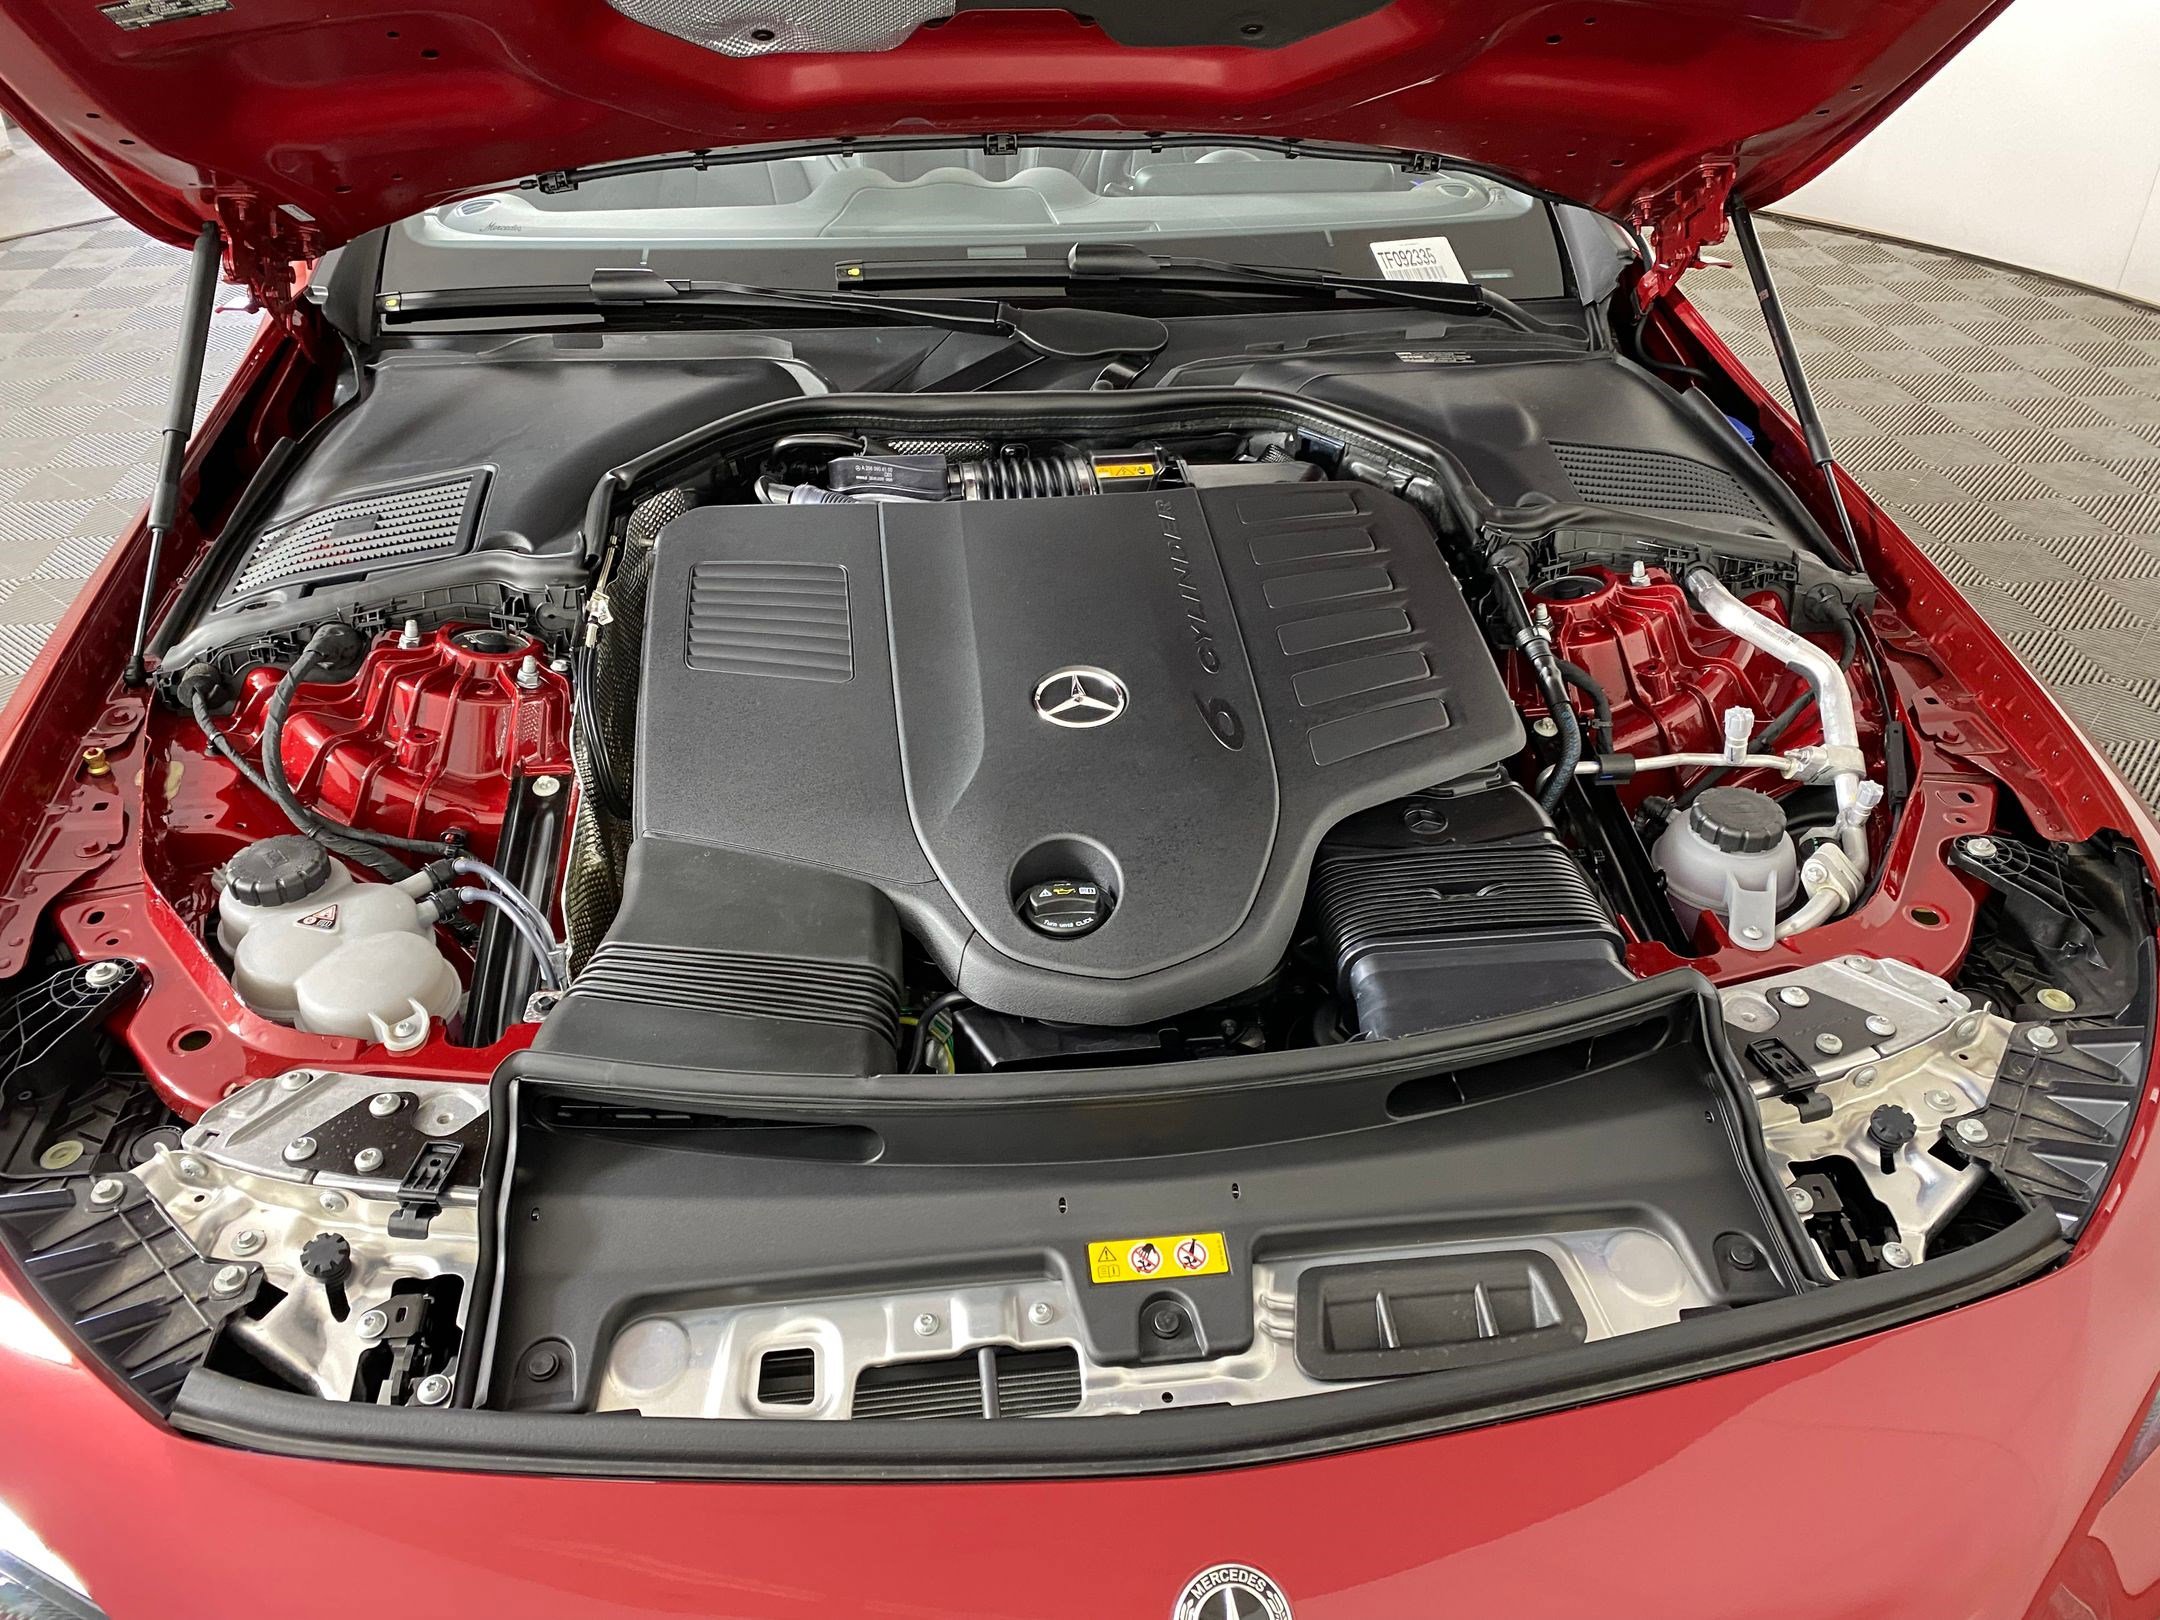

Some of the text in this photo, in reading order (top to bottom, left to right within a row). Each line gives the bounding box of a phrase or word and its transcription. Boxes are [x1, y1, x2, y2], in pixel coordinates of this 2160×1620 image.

[1377, 247, 1437, 270] TF092335
[1155, 499, 1220, 675] CYLINDER
[1043, 919, 1058, 927] Turn
[1075, 917, 1094, 927] CLICK
[1190, 1569, 1267, 1600] MERCEDES
